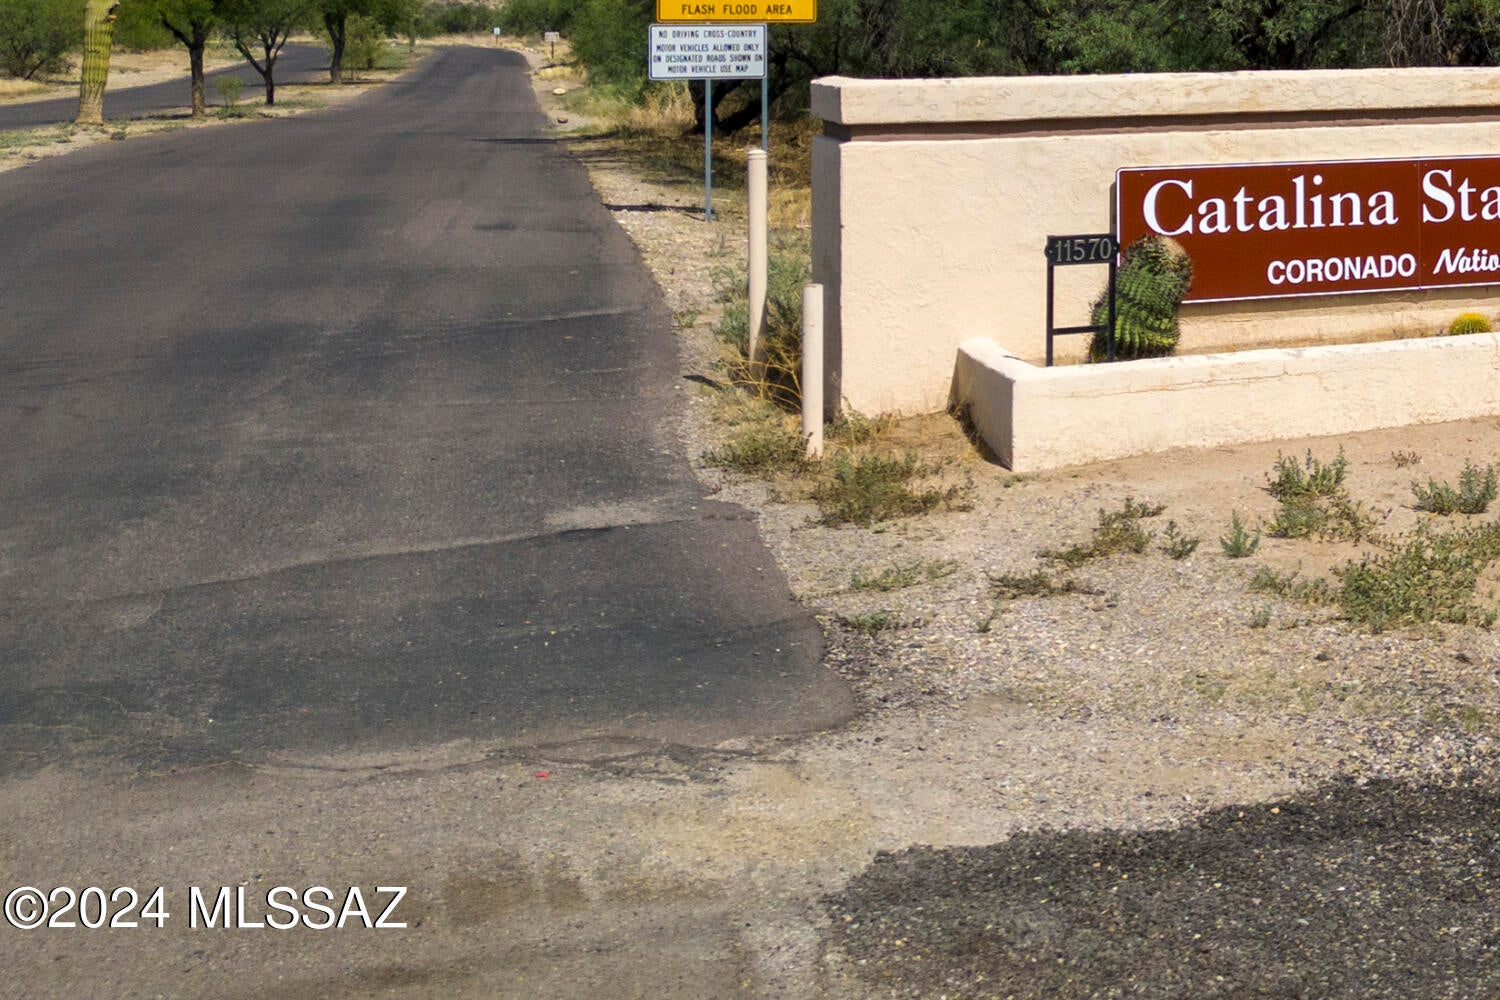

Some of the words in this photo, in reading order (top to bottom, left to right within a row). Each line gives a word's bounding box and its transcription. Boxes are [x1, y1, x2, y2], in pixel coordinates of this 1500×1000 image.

[682, 5, 714, 14] FLASH
[724, 5, 757, 14] FLOOD
[766, 5, 792, 14] AREA
[680, 44, 708, 52] VEHICLES
[1143, 174, 1398, 236] Catalina
[1055, 239, 1111, 261] 11570
[1267, 254, 1415, 285] CORONADO
